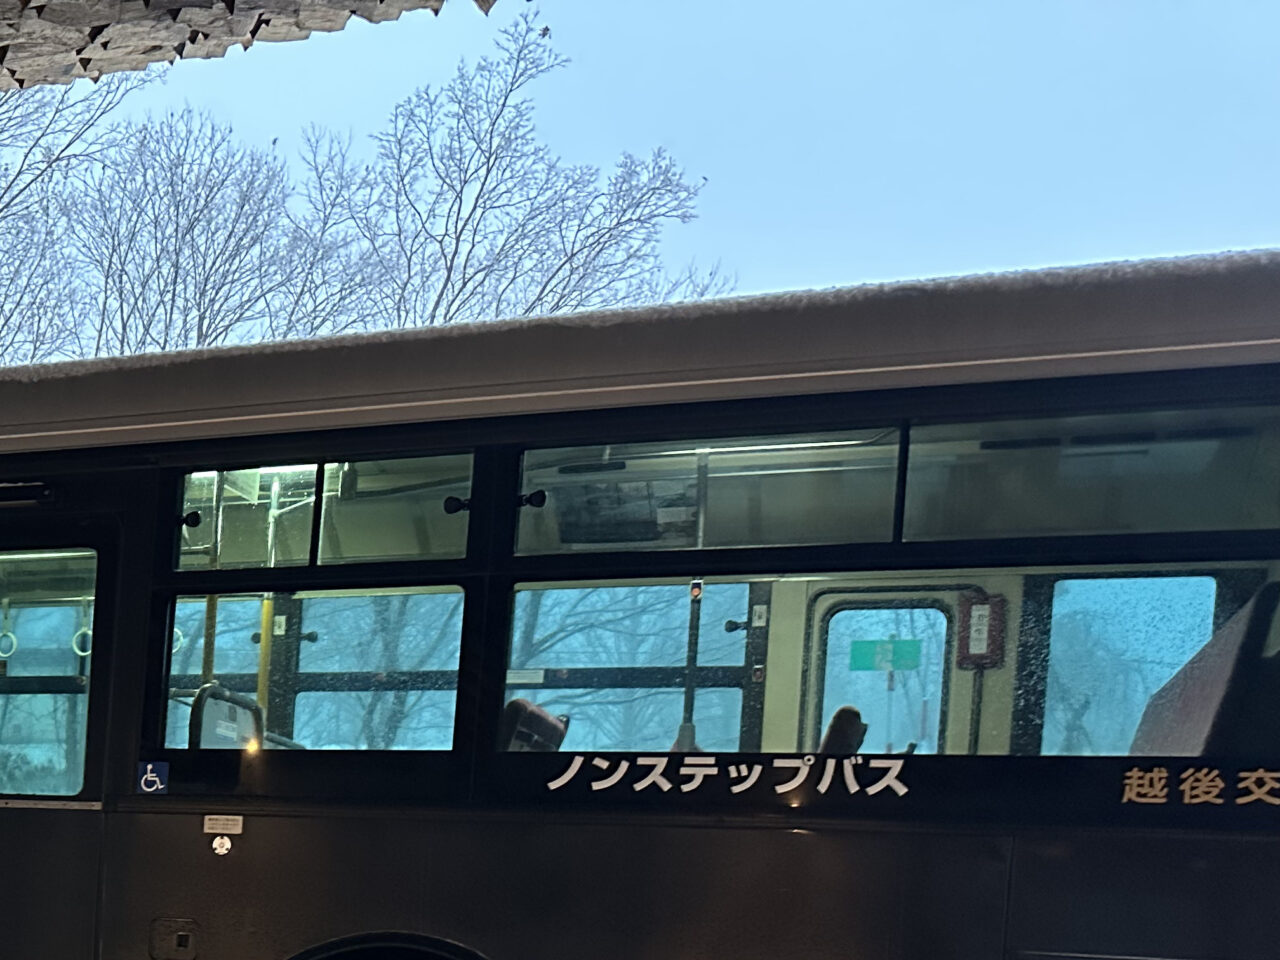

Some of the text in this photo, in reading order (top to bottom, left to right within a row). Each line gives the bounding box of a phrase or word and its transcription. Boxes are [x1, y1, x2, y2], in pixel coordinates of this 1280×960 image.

[546, 754, 909, 797] ノンステップバス
[1121, 767, 1280, 804] 越後交
